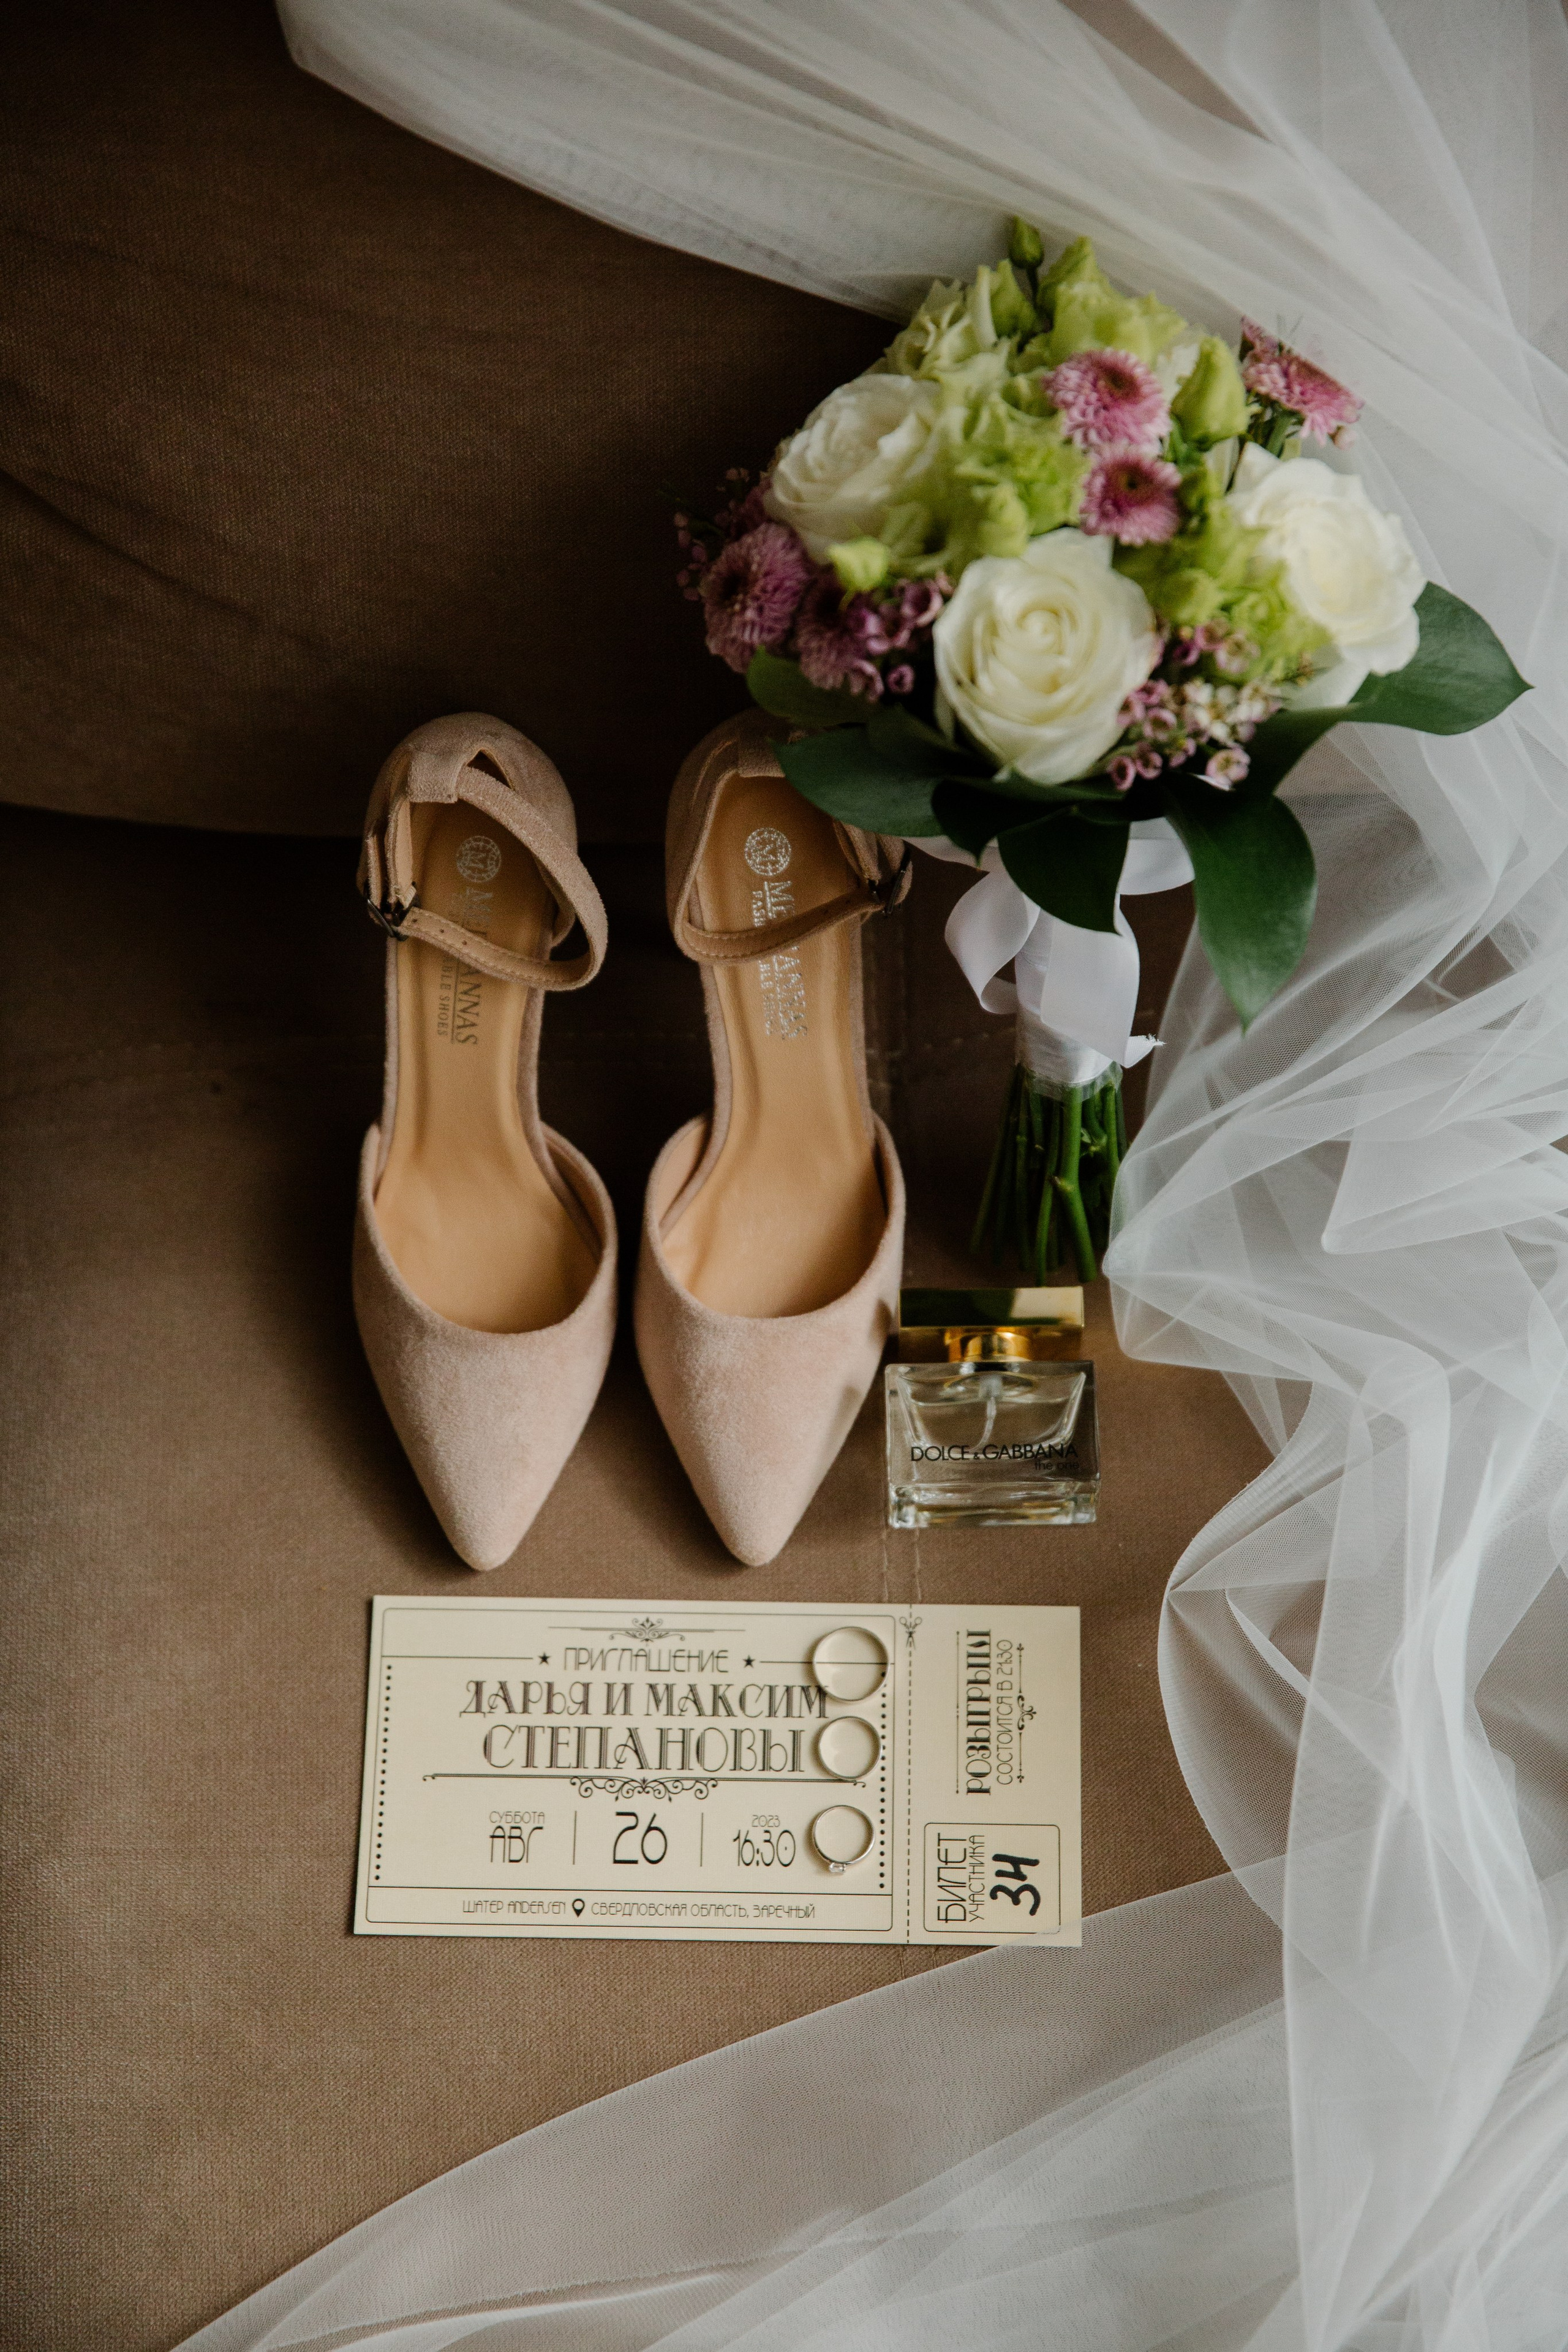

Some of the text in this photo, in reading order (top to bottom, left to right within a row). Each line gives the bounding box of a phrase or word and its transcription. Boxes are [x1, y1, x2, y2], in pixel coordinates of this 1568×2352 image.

[437, 995, 450, 1036] SHOES
[911, 1446, 970, 1461] DOLCE
[982, 1443, 1078, 1460] GABBANA
[564, 1648, 728, 1673] ПРИГЛАШЕНИЕ
[459, 1680, 828, 1718] ДАРЬЯ И МАКСИМ
[966, 1629, 991, 1795] РОЗЫГРЫШ
[997, 1640, 1012, 1785] СОСТОИТСЯ В 21:30
[483, 1724, 805, 1772] СТЕПАНОВЫ
[489, 1811, 545, 1824] СУББОТА
[752, 1815, 780, 1827] 2023
[489, 1825, 543, 1863] АВГ
[612, 1812, 668, 1864] 26
[733, 1830, 796, 1867] 16:30
[937, 1833, 967, 1923] БИЛЕТ
[969, 1835, 984, 1922] УЧАСТНИКА
[990, 1854, 1041, 1916] 34
[462, 1900, 566, 1914] ШАТЕР ANDERSEN
[591, 1902, 815, 1918] СВЕРДЛОВСКАЯ ОБЛАСТЬ, ЗАРЕЧНЫЙ
